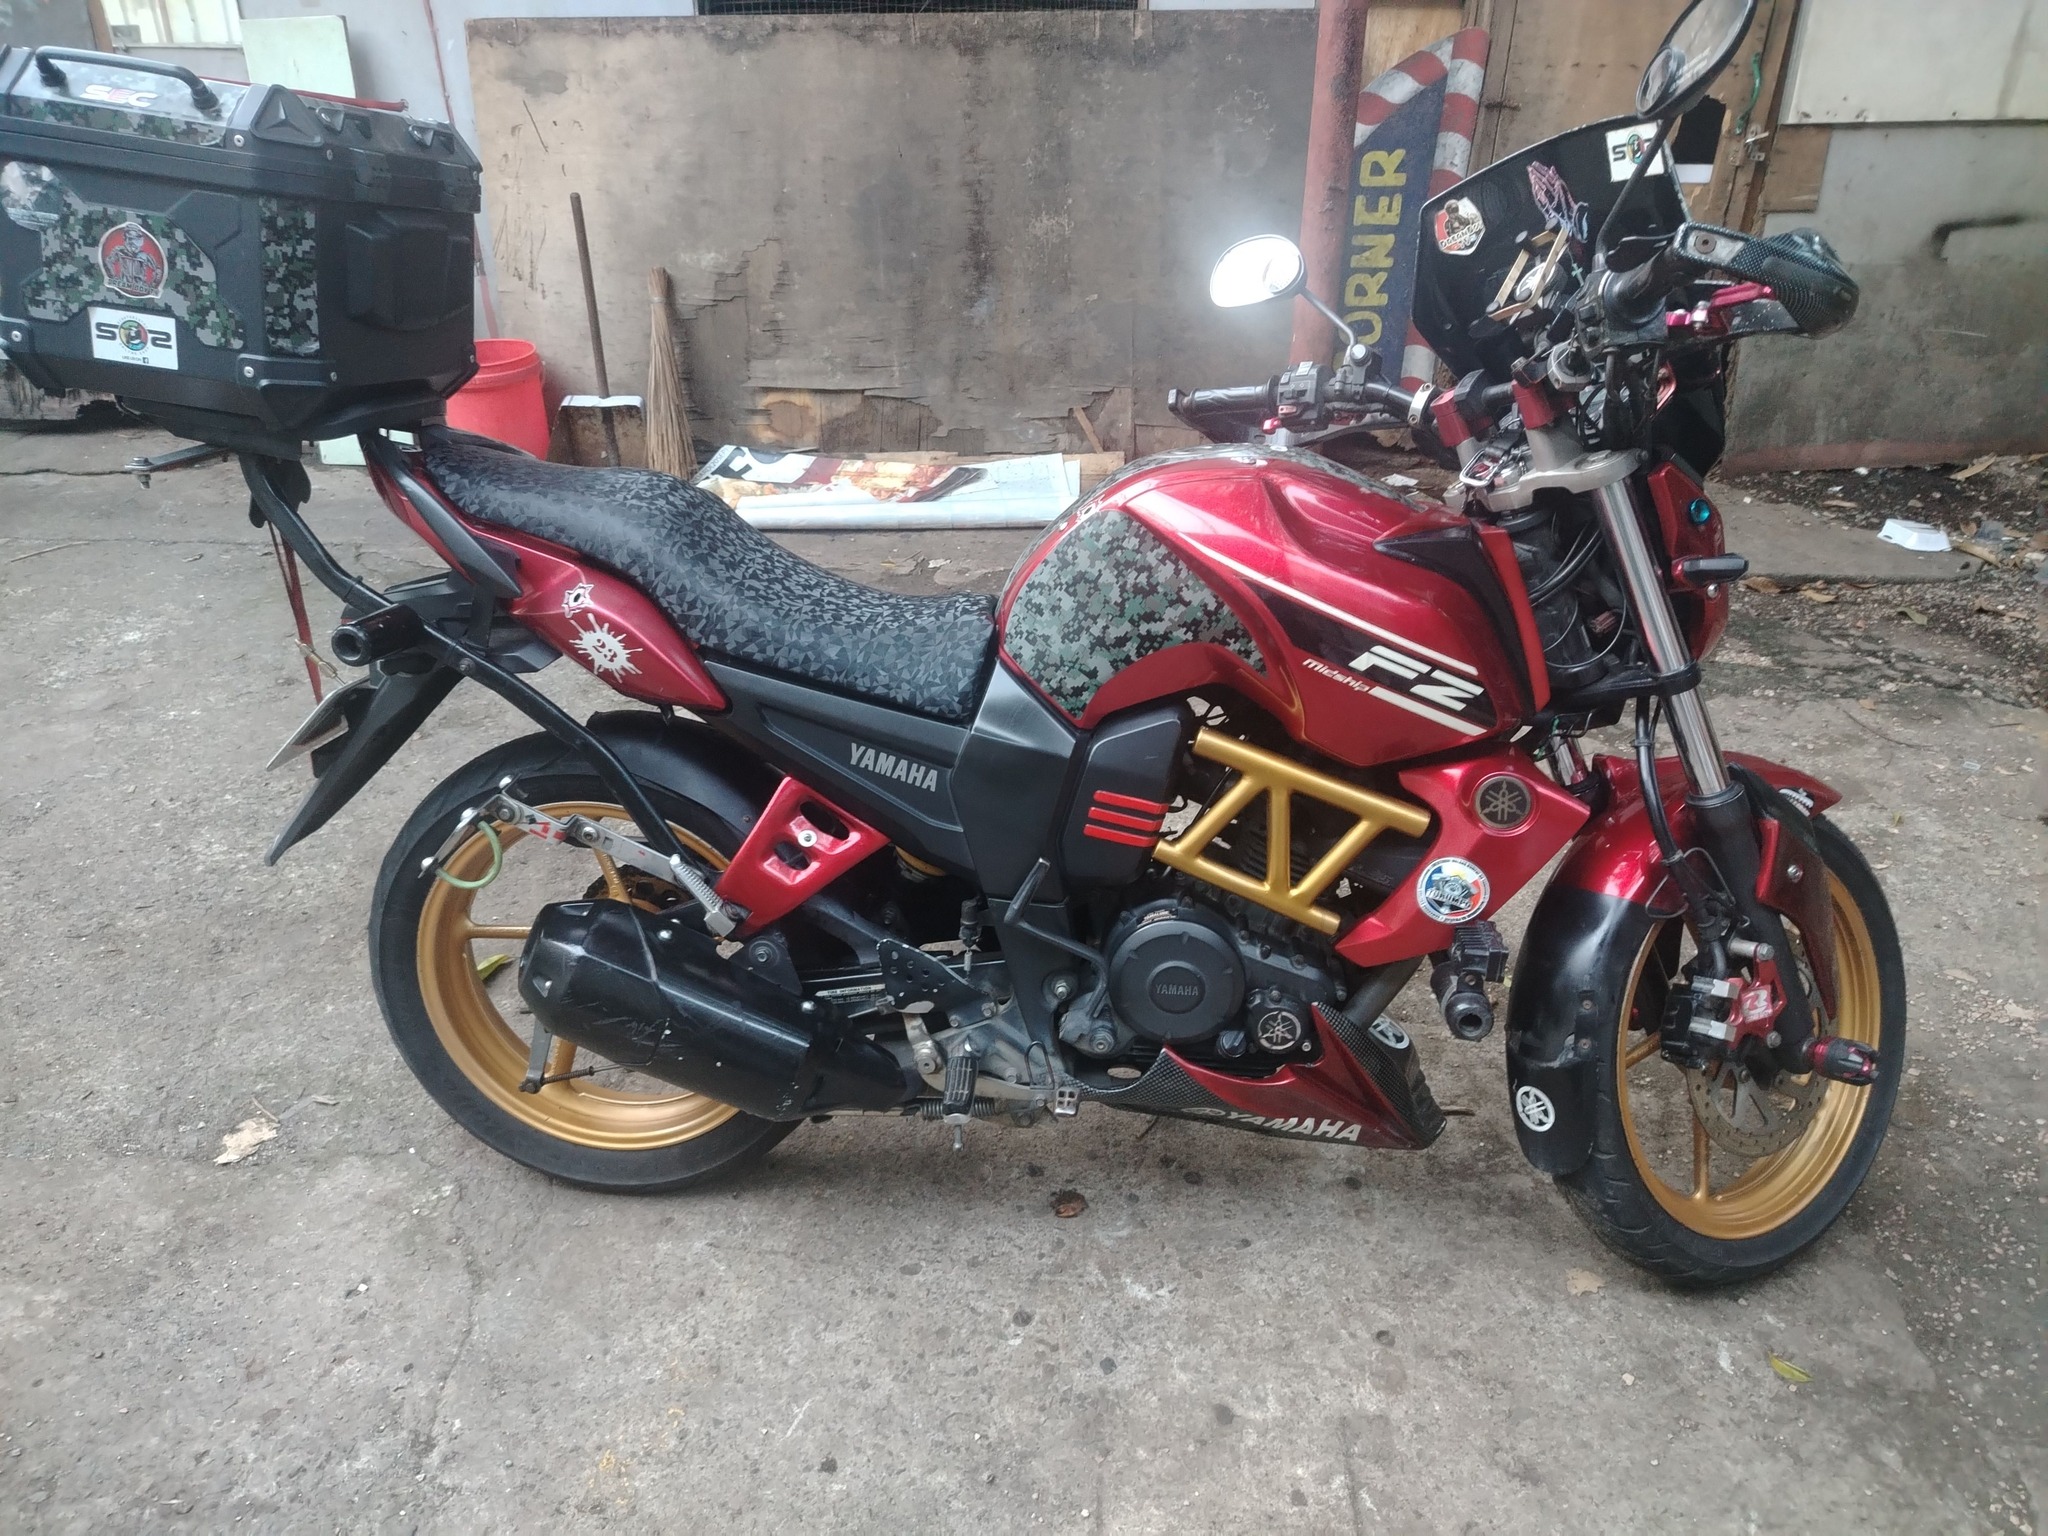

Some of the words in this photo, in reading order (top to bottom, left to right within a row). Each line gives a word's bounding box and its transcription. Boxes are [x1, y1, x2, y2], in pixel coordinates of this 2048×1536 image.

[79, 84, 159, 108] SEC
[1348, 645, 1484, 711] FZ
[850, 742, 938, 792] YAMAHA
[1155, 984, 1199, 996] YAMAHA
[1227, 1111, 1362, 1142] YAMAHA
